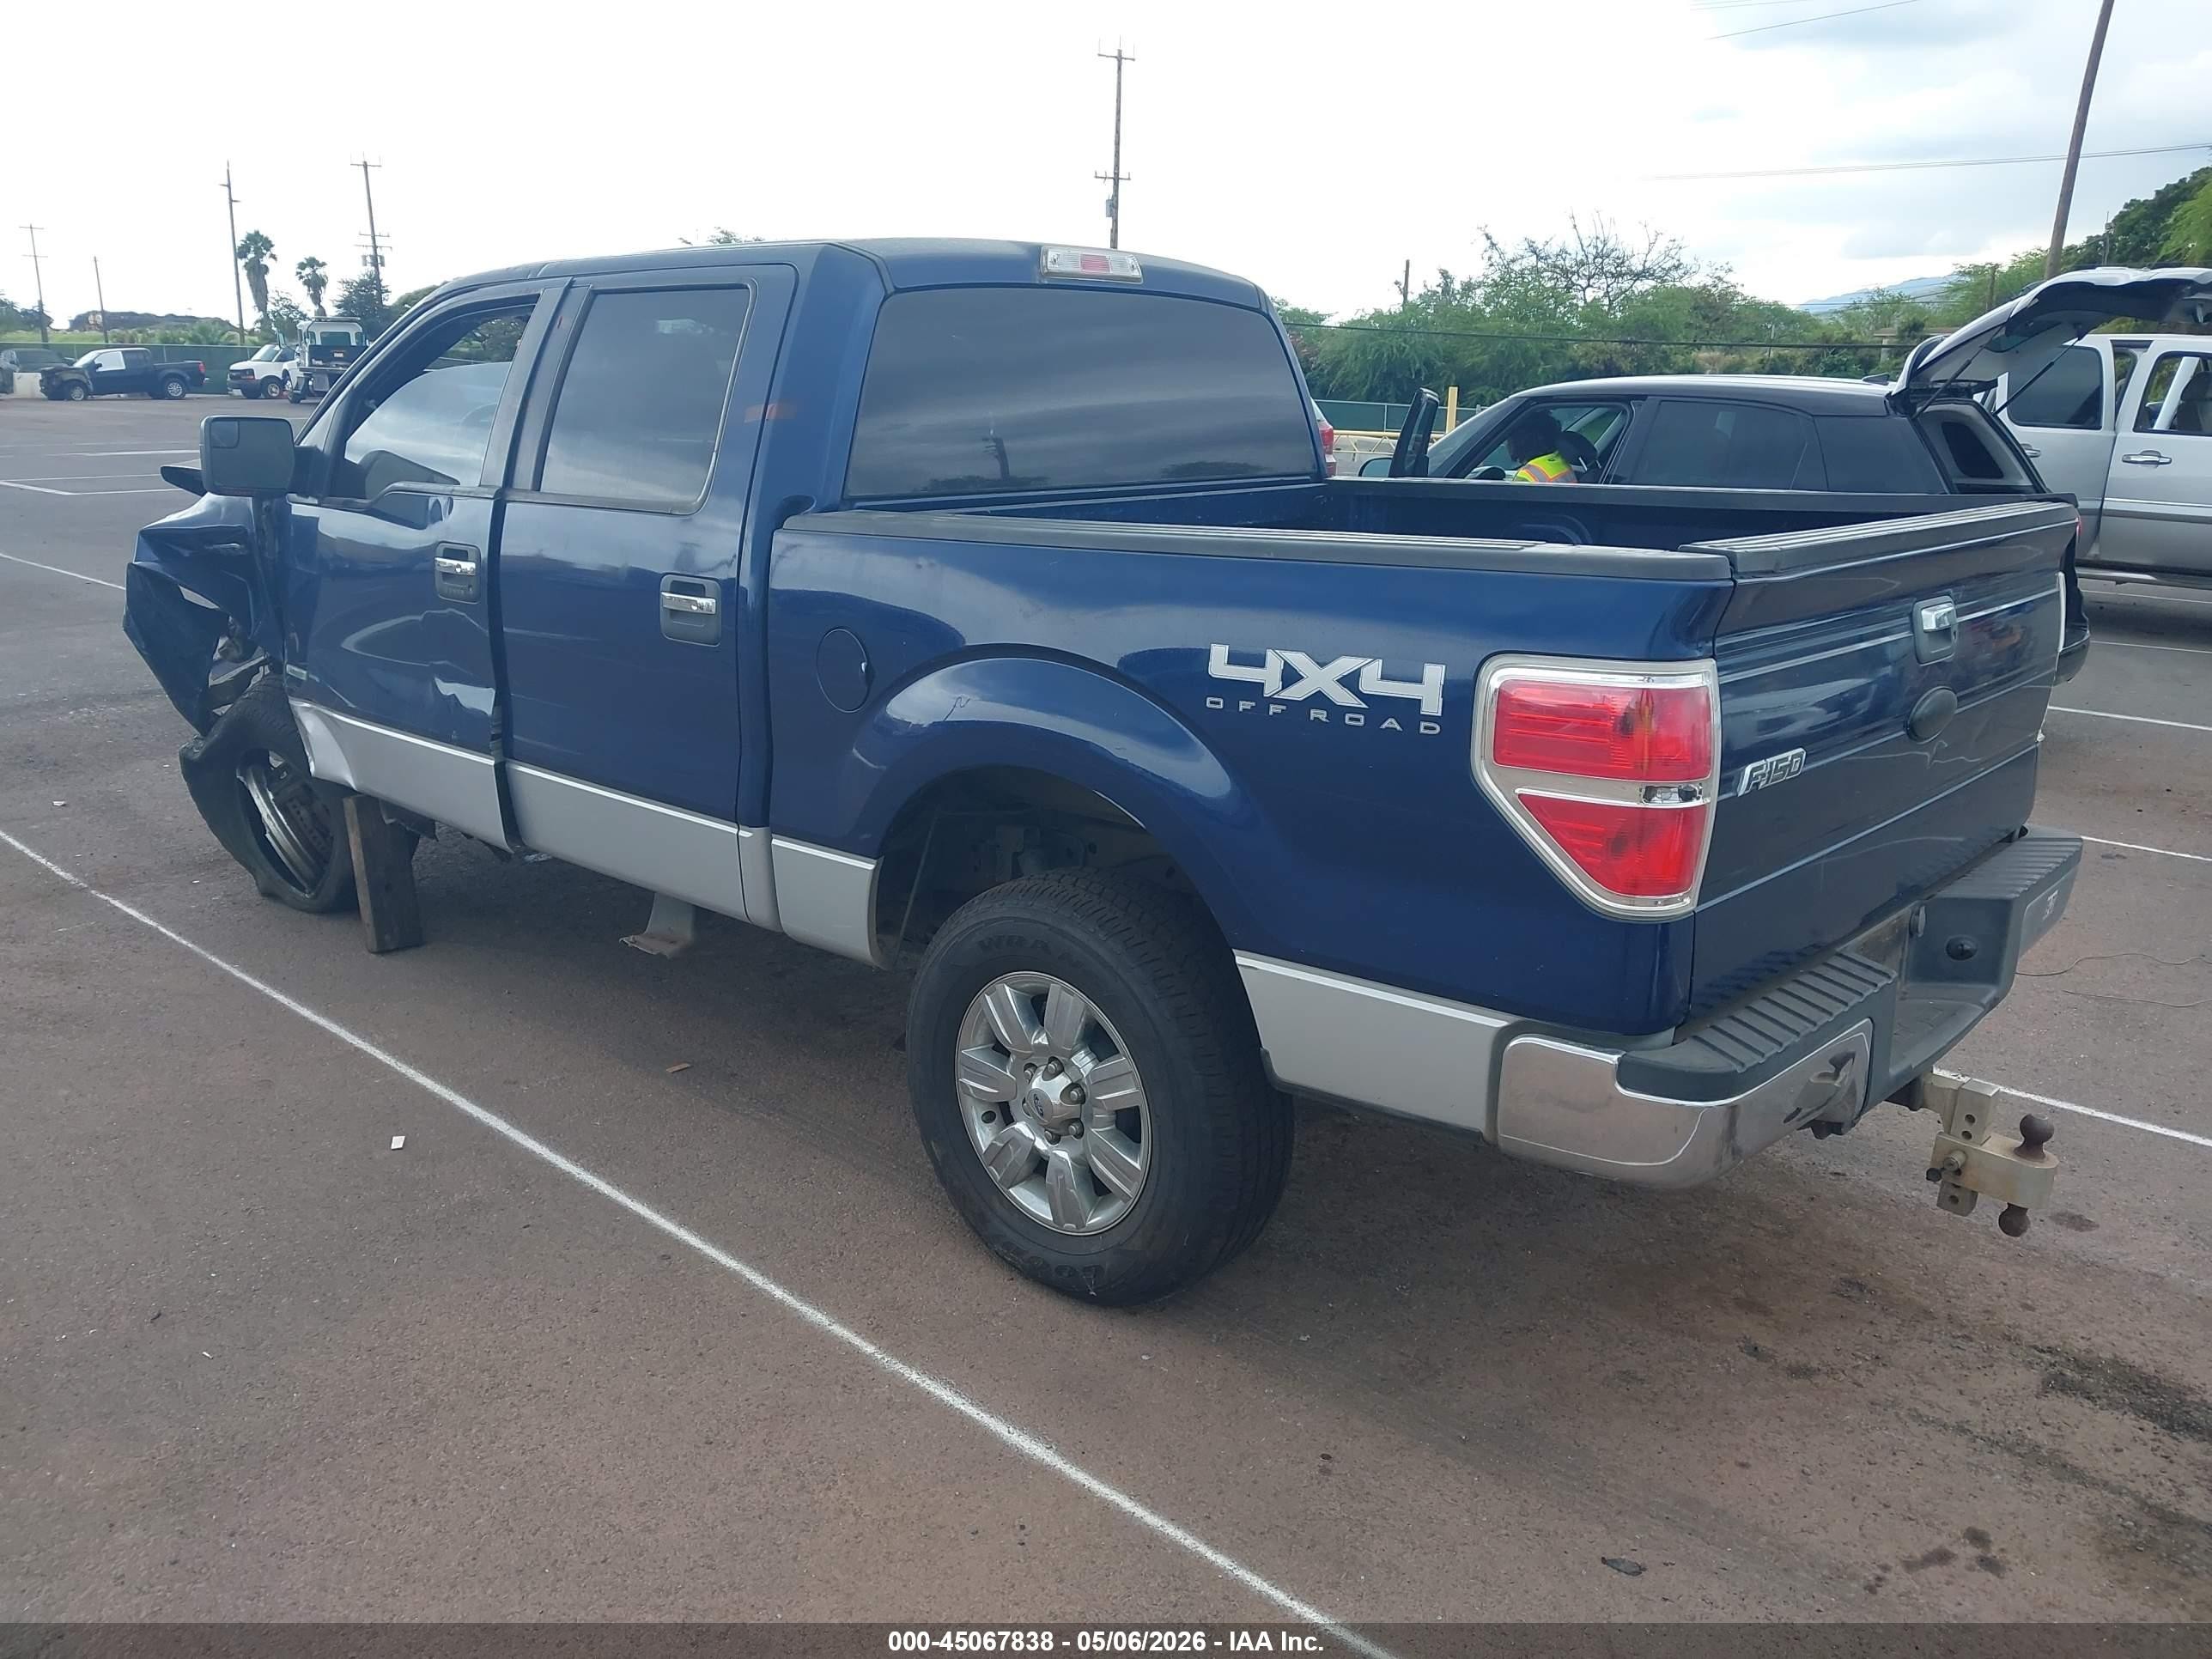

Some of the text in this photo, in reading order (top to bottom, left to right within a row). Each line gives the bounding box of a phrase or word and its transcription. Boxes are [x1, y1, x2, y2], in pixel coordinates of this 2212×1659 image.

[1208, 643, 1447, 717] 4X4
[1206, 696, 1441, 736] OFF ROAD
